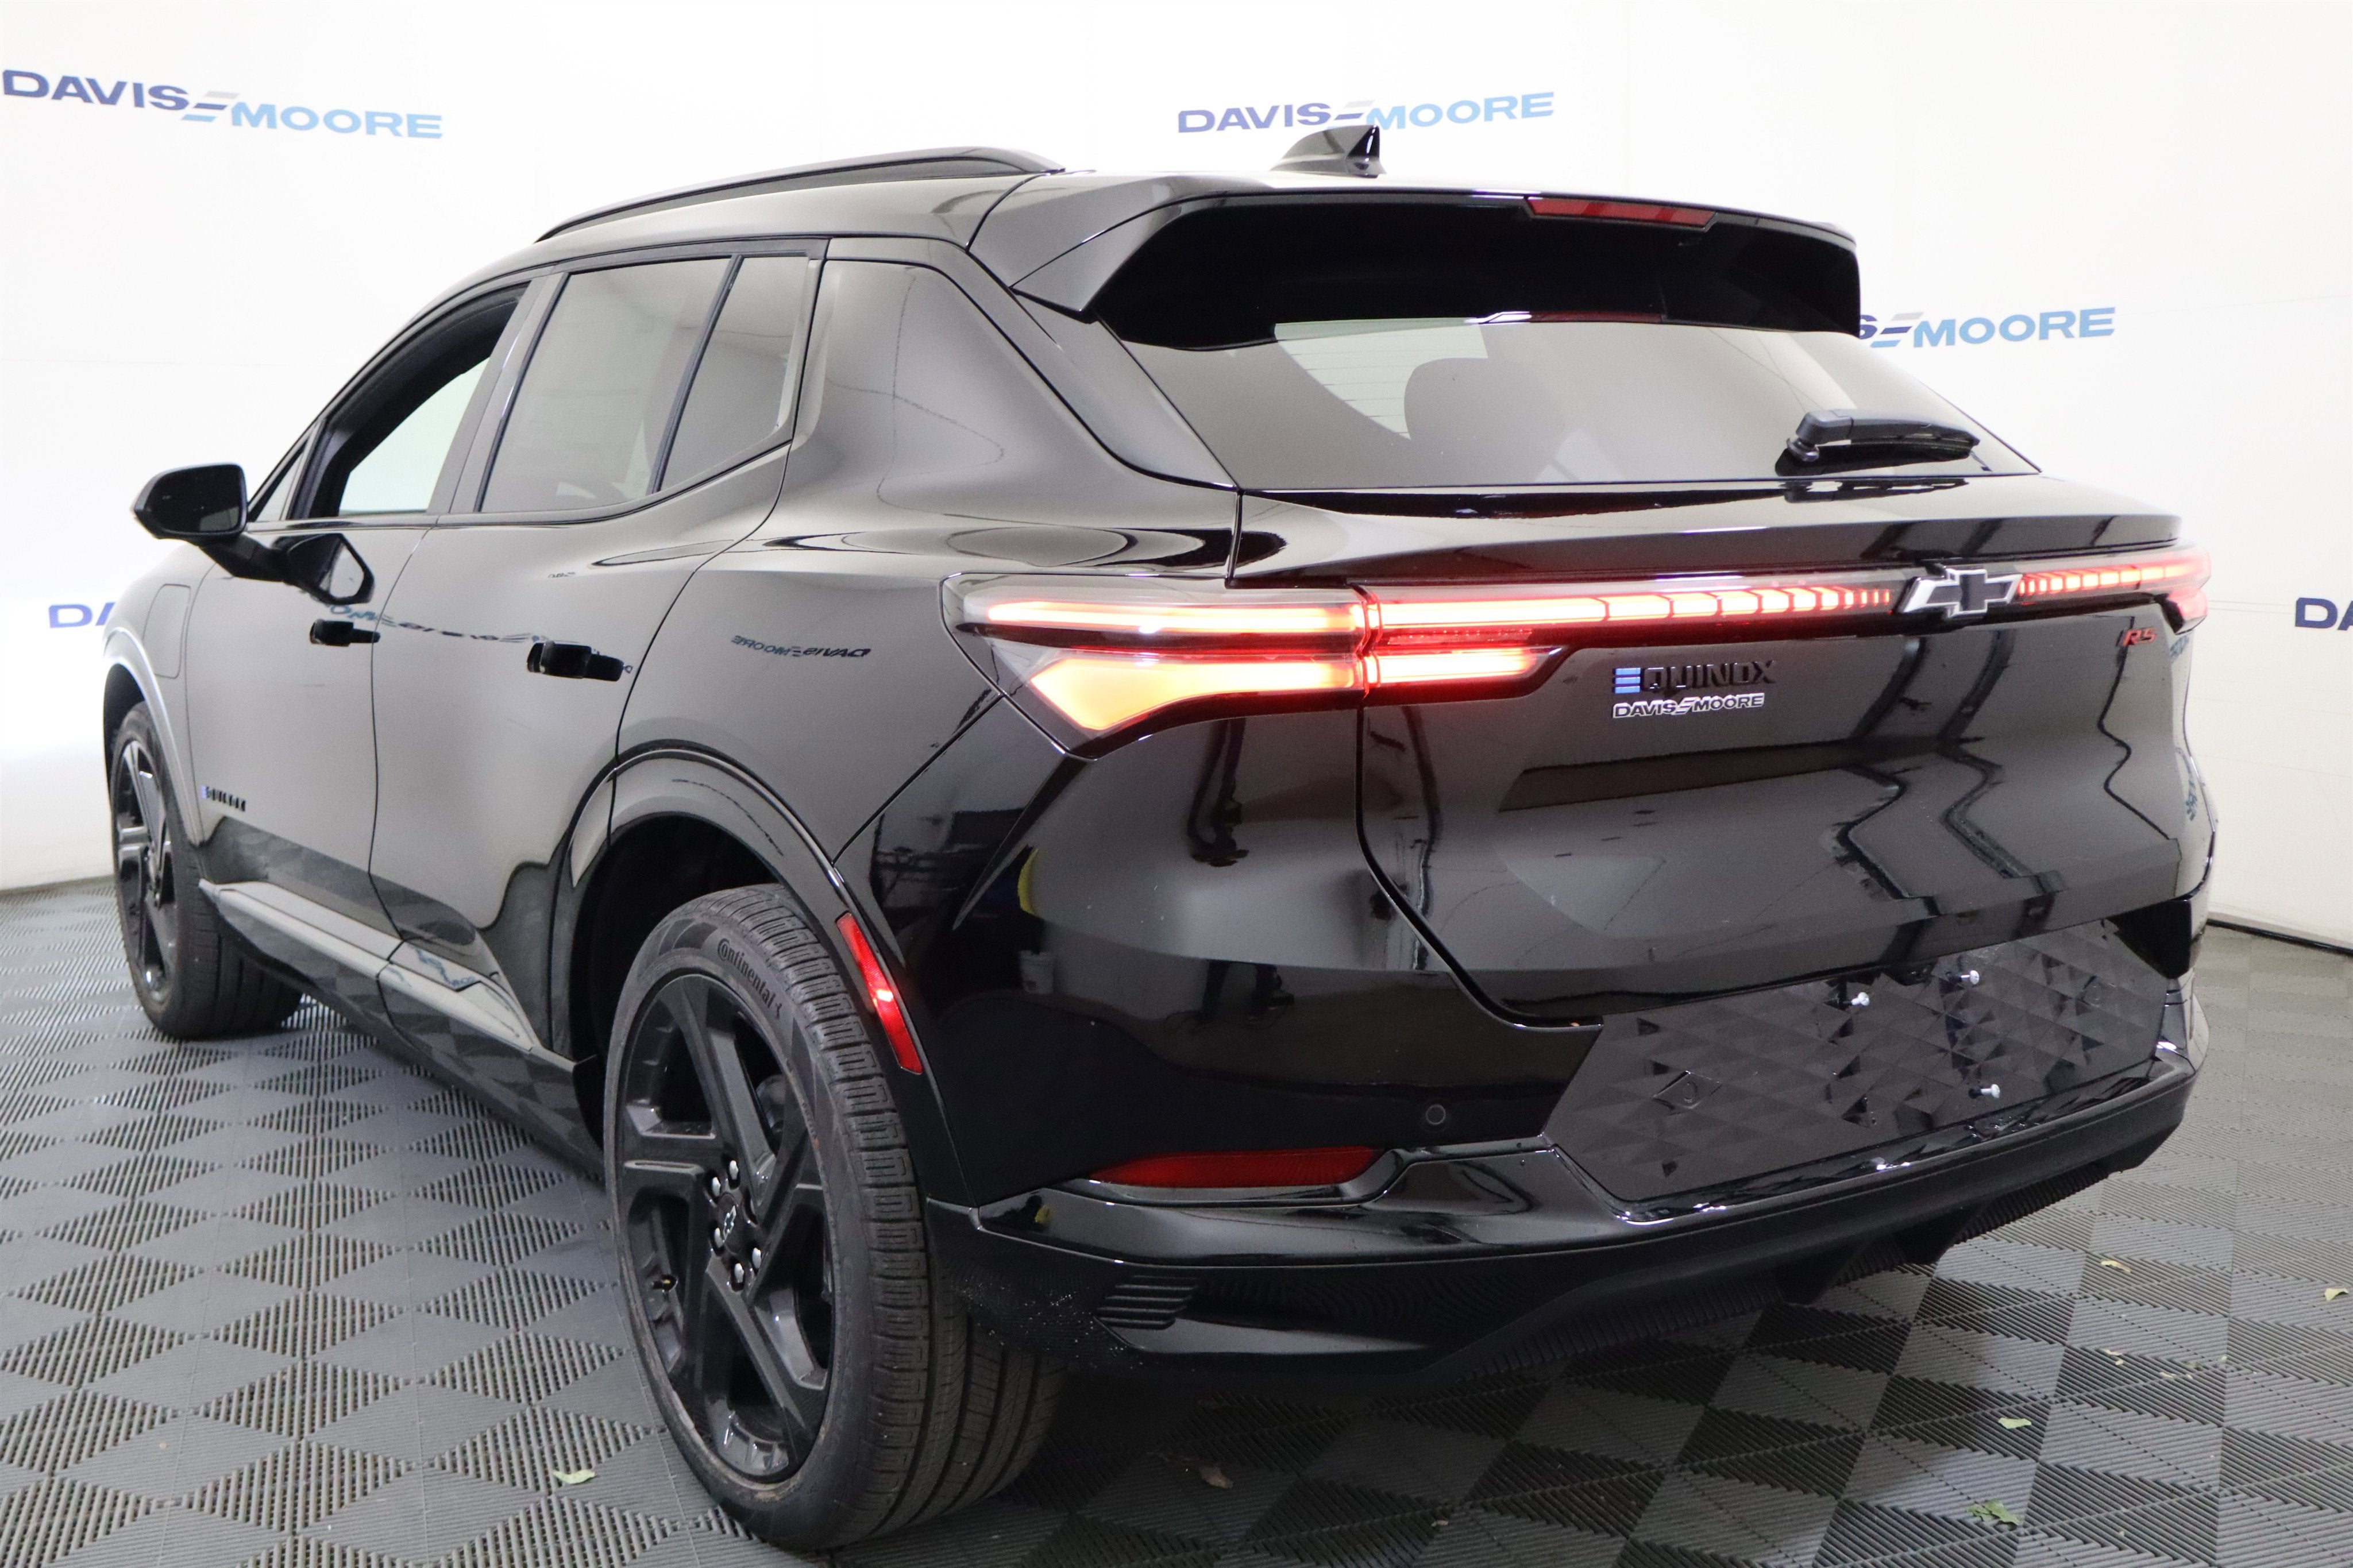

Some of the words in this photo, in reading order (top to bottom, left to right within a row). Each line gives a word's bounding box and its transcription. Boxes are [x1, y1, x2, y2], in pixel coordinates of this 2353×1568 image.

[2, 69, 190, 111] DAVIS
[232, 102, 443, 138] MOORE
[1178, 103, 1331, 133] DAVIS
[1367, 92, 1554, 131] MOORE
[1914, 307, 2115, 347] MOORE
[2123, 627, 2158, 646] RS
[1613, 661, 1777, 694] EQUINOX
[1613, 698, 1679, 718] DAVIS
[1692, 693, 1764, 712] MOORE
[718, 938, 776, 1008] Continental
